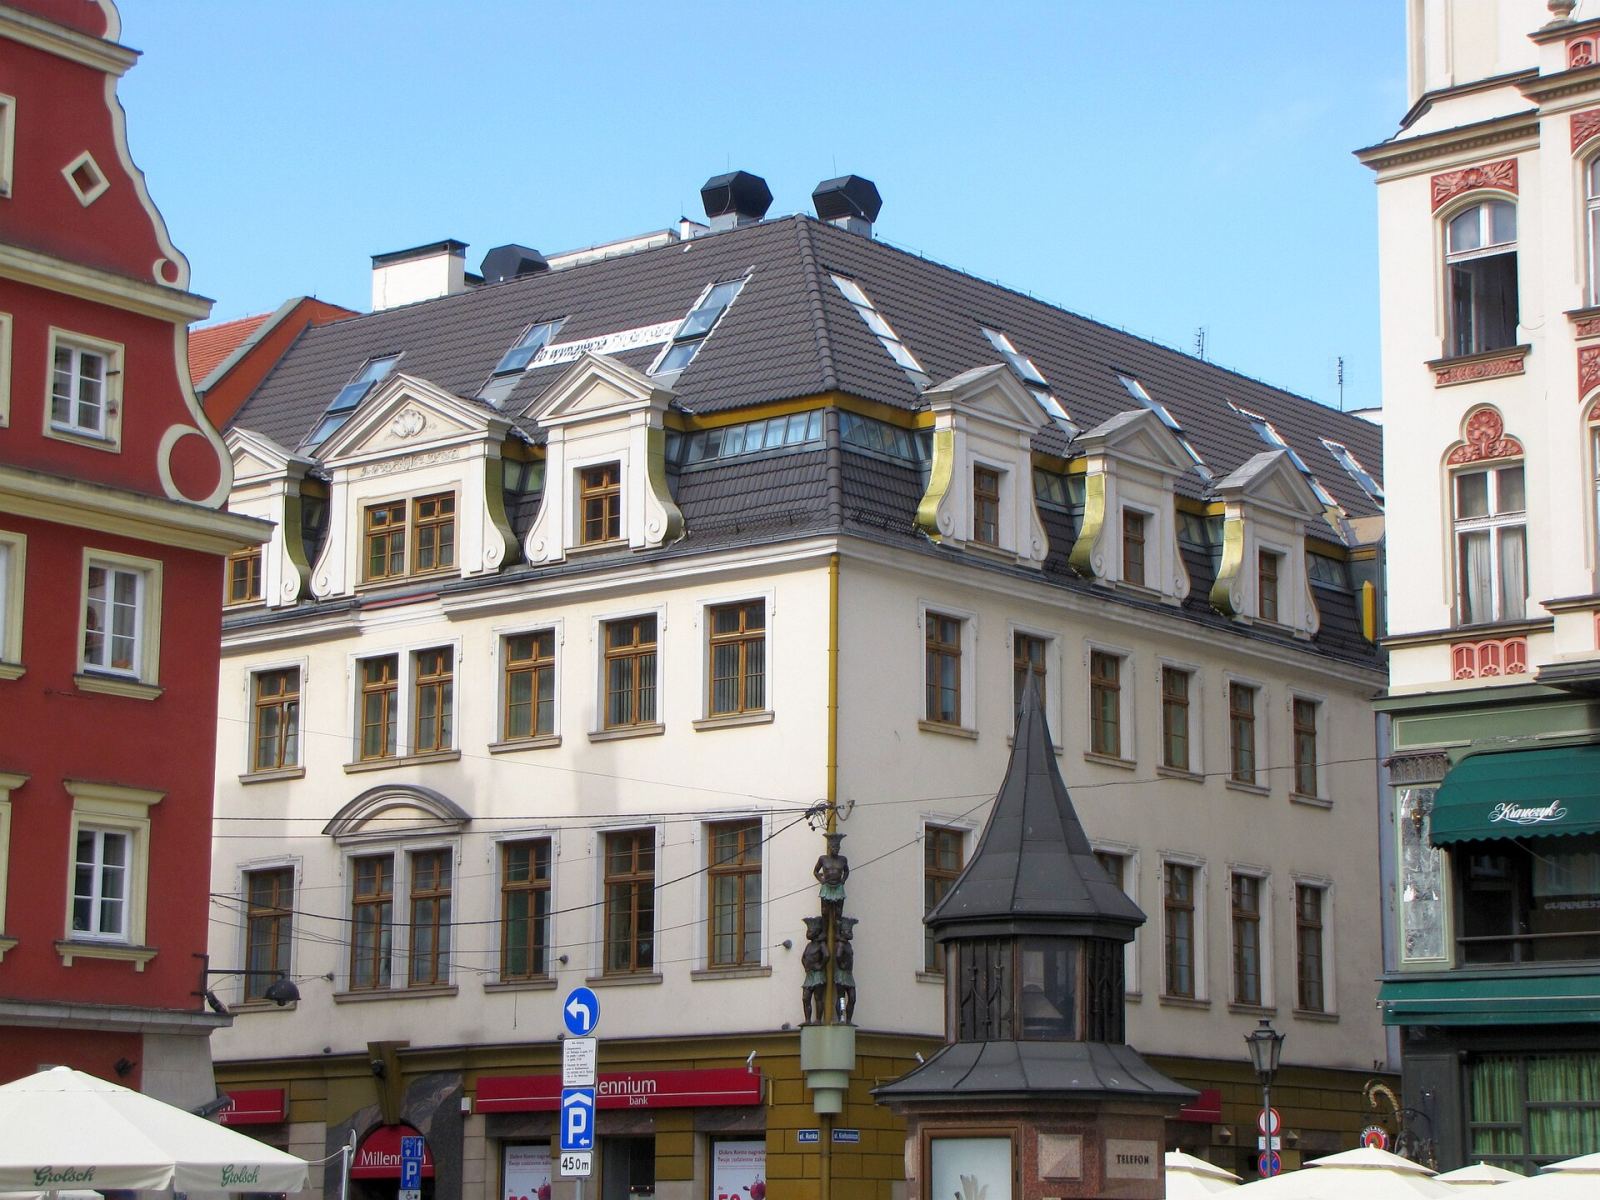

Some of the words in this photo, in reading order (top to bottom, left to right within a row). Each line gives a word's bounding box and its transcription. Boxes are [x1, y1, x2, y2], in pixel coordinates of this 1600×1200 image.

[629, 1095, 648, 1105] bank
[1117, 1154, 1149, 1165] TELEFON
[34, 1165, 96, 1186] Grolsch
[221, 1164, 260, 1188] Grolsch
